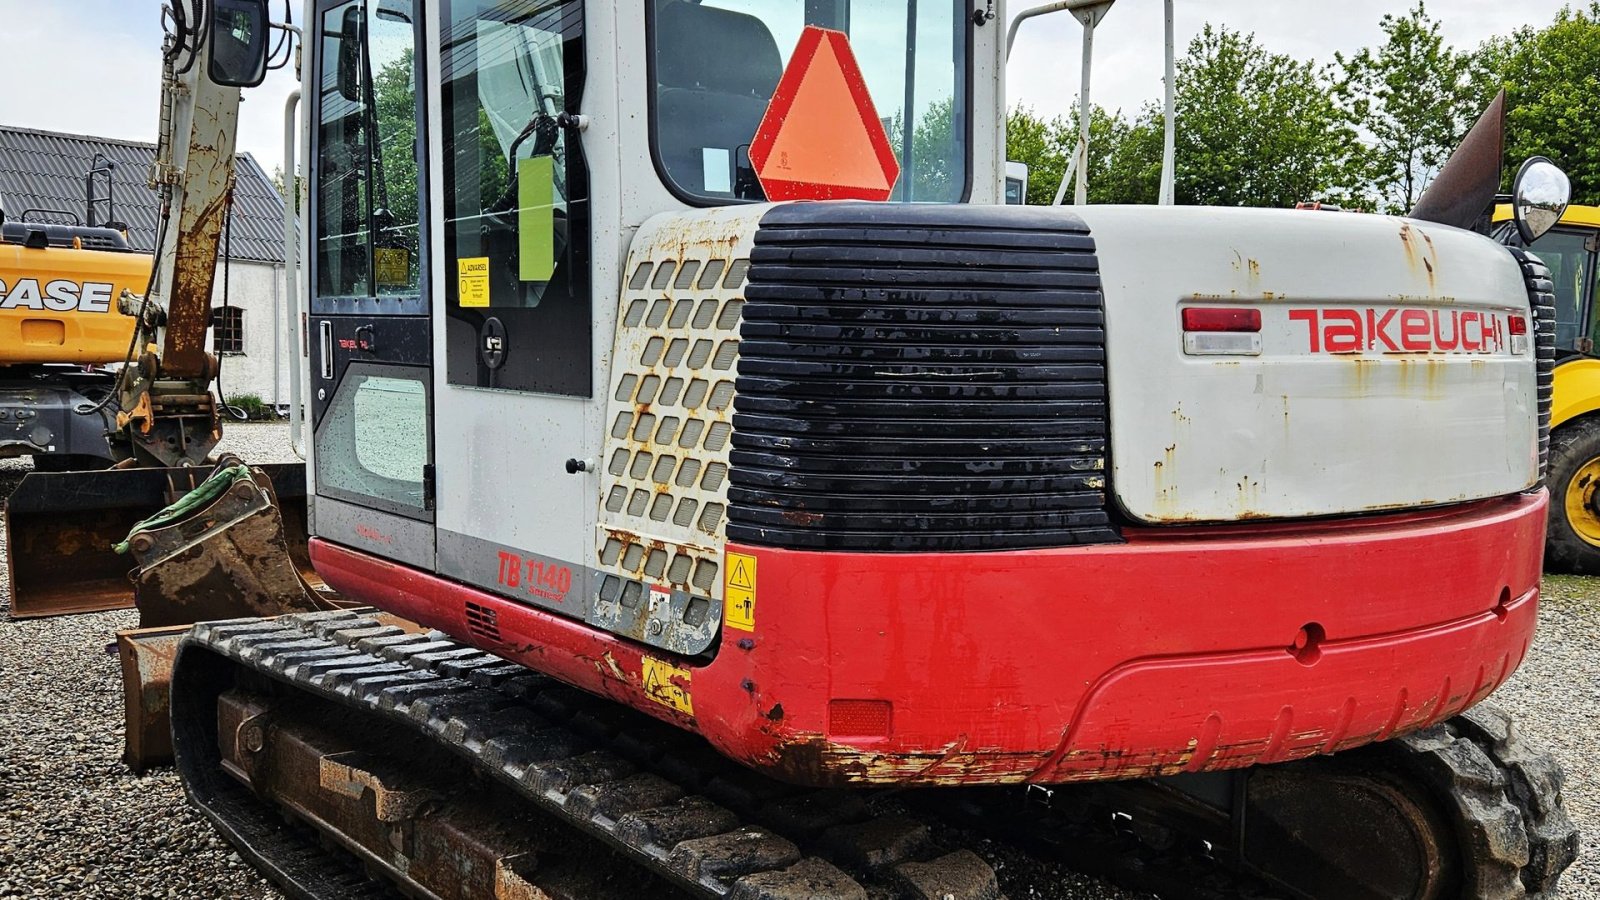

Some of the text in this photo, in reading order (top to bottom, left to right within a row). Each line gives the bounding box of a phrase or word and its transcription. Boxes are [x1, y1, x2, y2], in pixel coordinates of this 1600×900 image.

[0, 278, 114, 313] ASE
[497, 550, 572, 594] TB 1140
